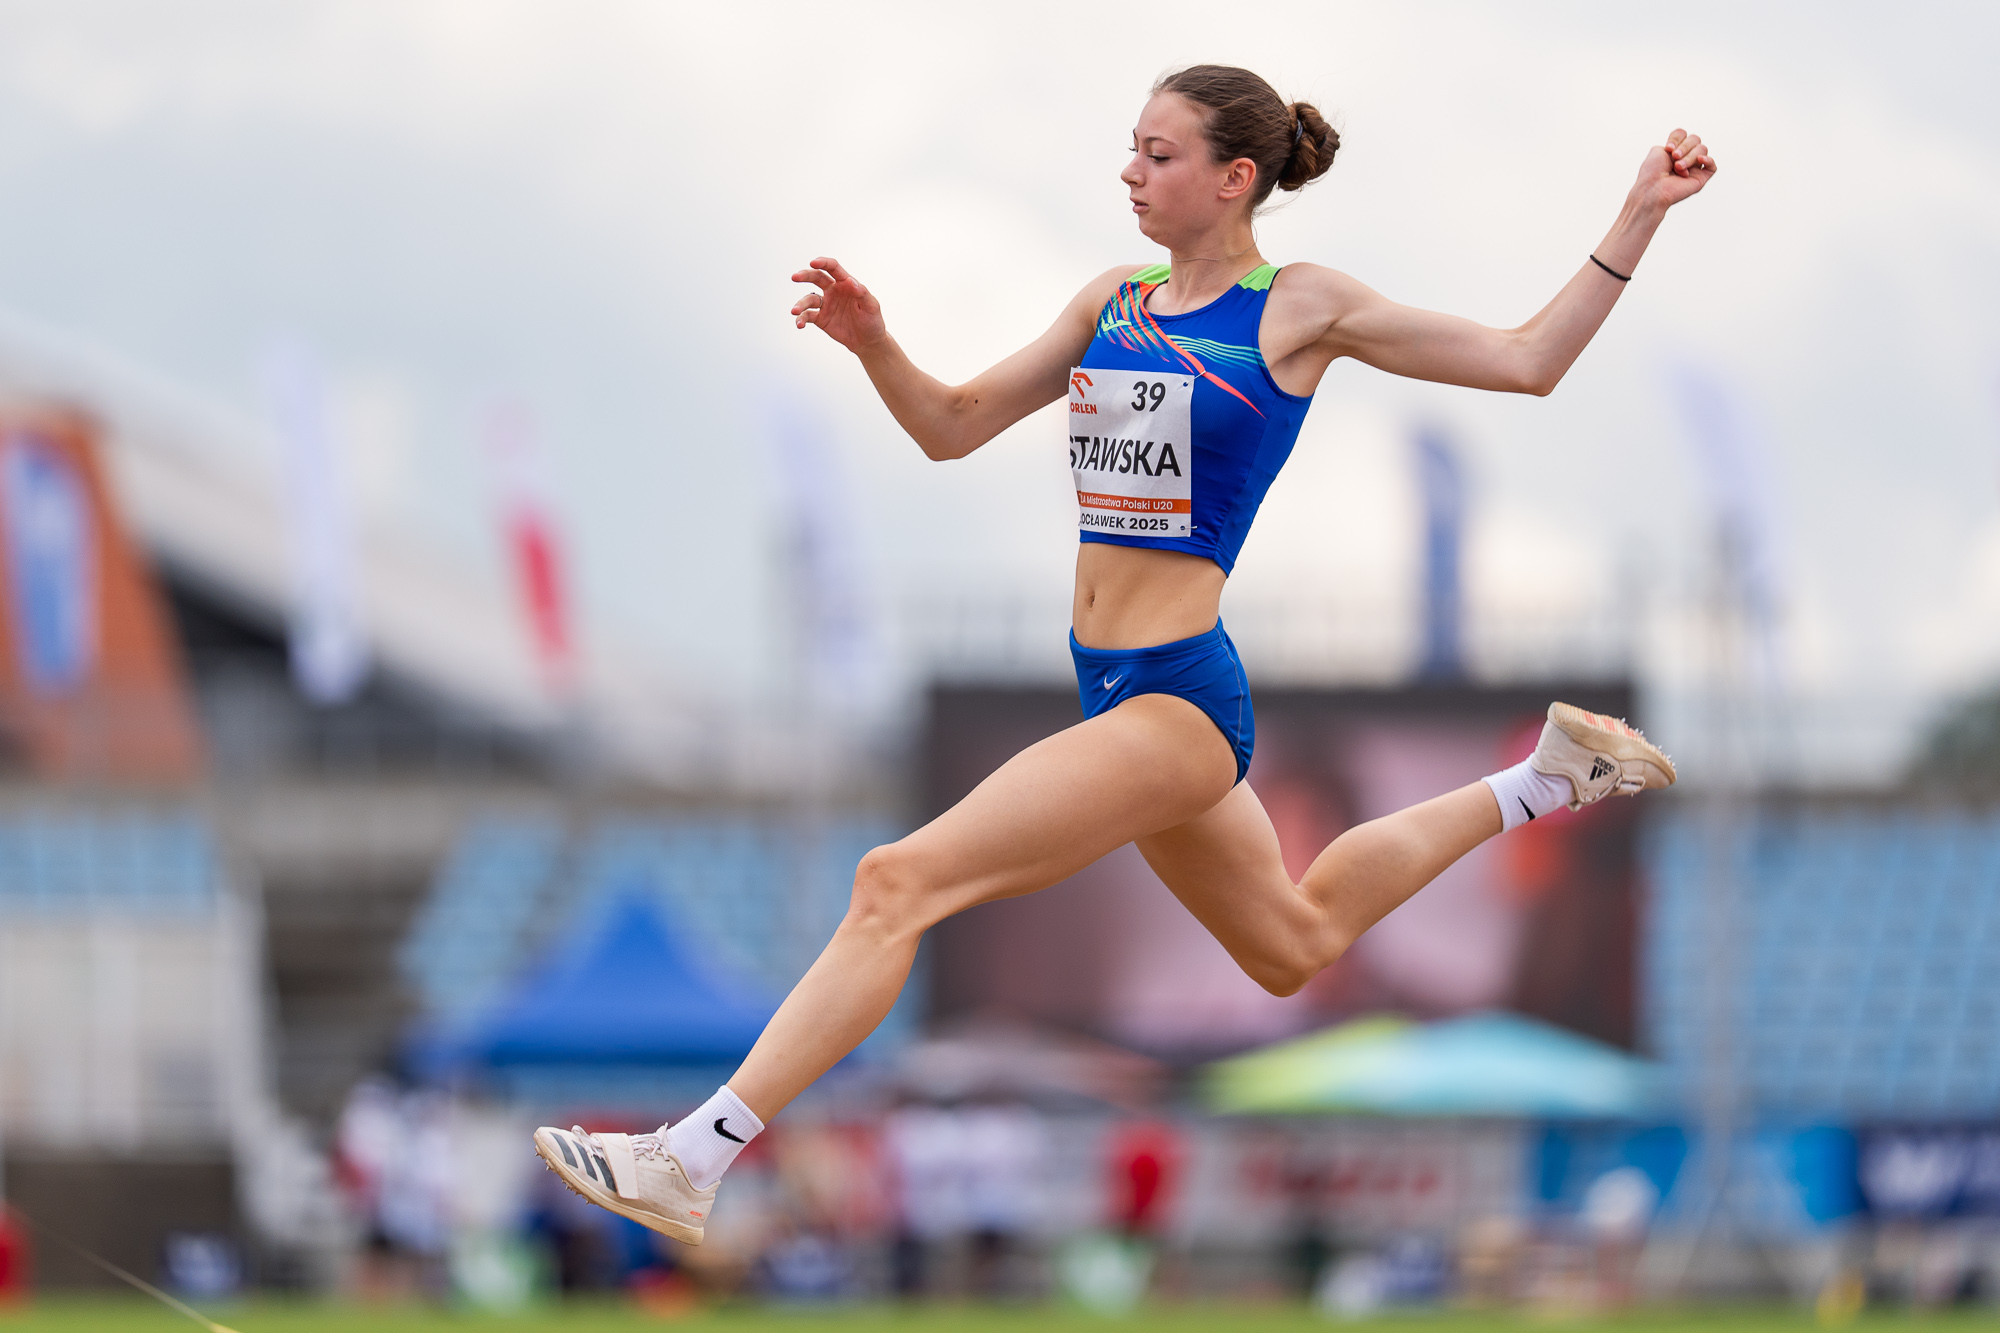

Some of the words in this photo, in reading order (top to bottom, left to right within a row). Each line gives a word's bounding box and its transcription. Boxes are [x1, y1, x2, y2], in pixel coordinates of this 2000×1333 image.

[1131, 381, 1166, 412] 39
[1070, 402, 1097, 414] ORLEN
[1086, 495, 1121, 508] Mistrzostwa
[1123, 499, 1150, 510] Polski
[1153, 501, 1173, 510] U20
[1129, 517, 1169, 531] 2025
